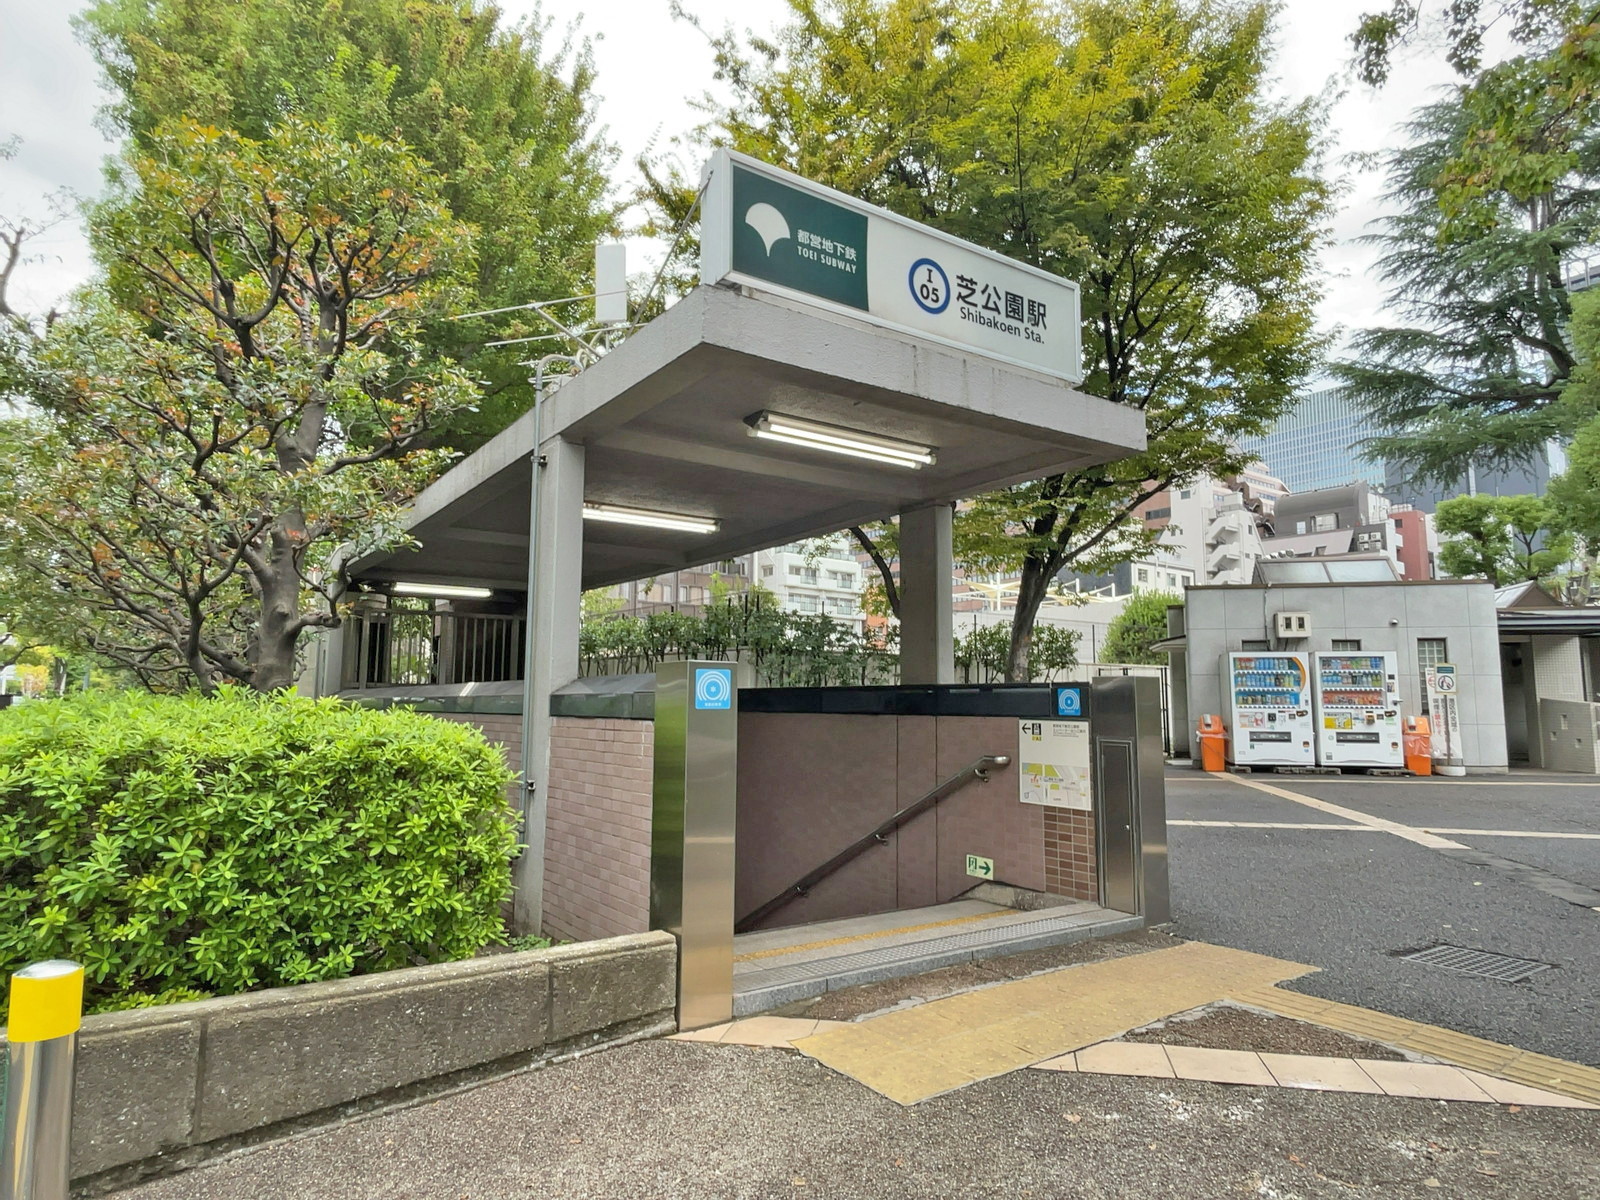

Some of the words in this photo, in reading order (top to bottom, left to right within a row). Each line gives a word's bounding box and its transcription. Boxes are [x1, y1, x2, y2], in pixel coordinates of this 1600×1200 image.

[797, 229, 857, 262] 都営地下鉄
[797, 245, 817, 261] TOEI
[820, 254, 857, 274] SUBWAY
[926, 268, 934, 284] I
[919, 283, 940, 304] 05
[955, 274, 1047, 330] 芝公園駅
[960, 306, 1021, 337] Shibakoen
[1024, 326, 1045, 345] Sta.
